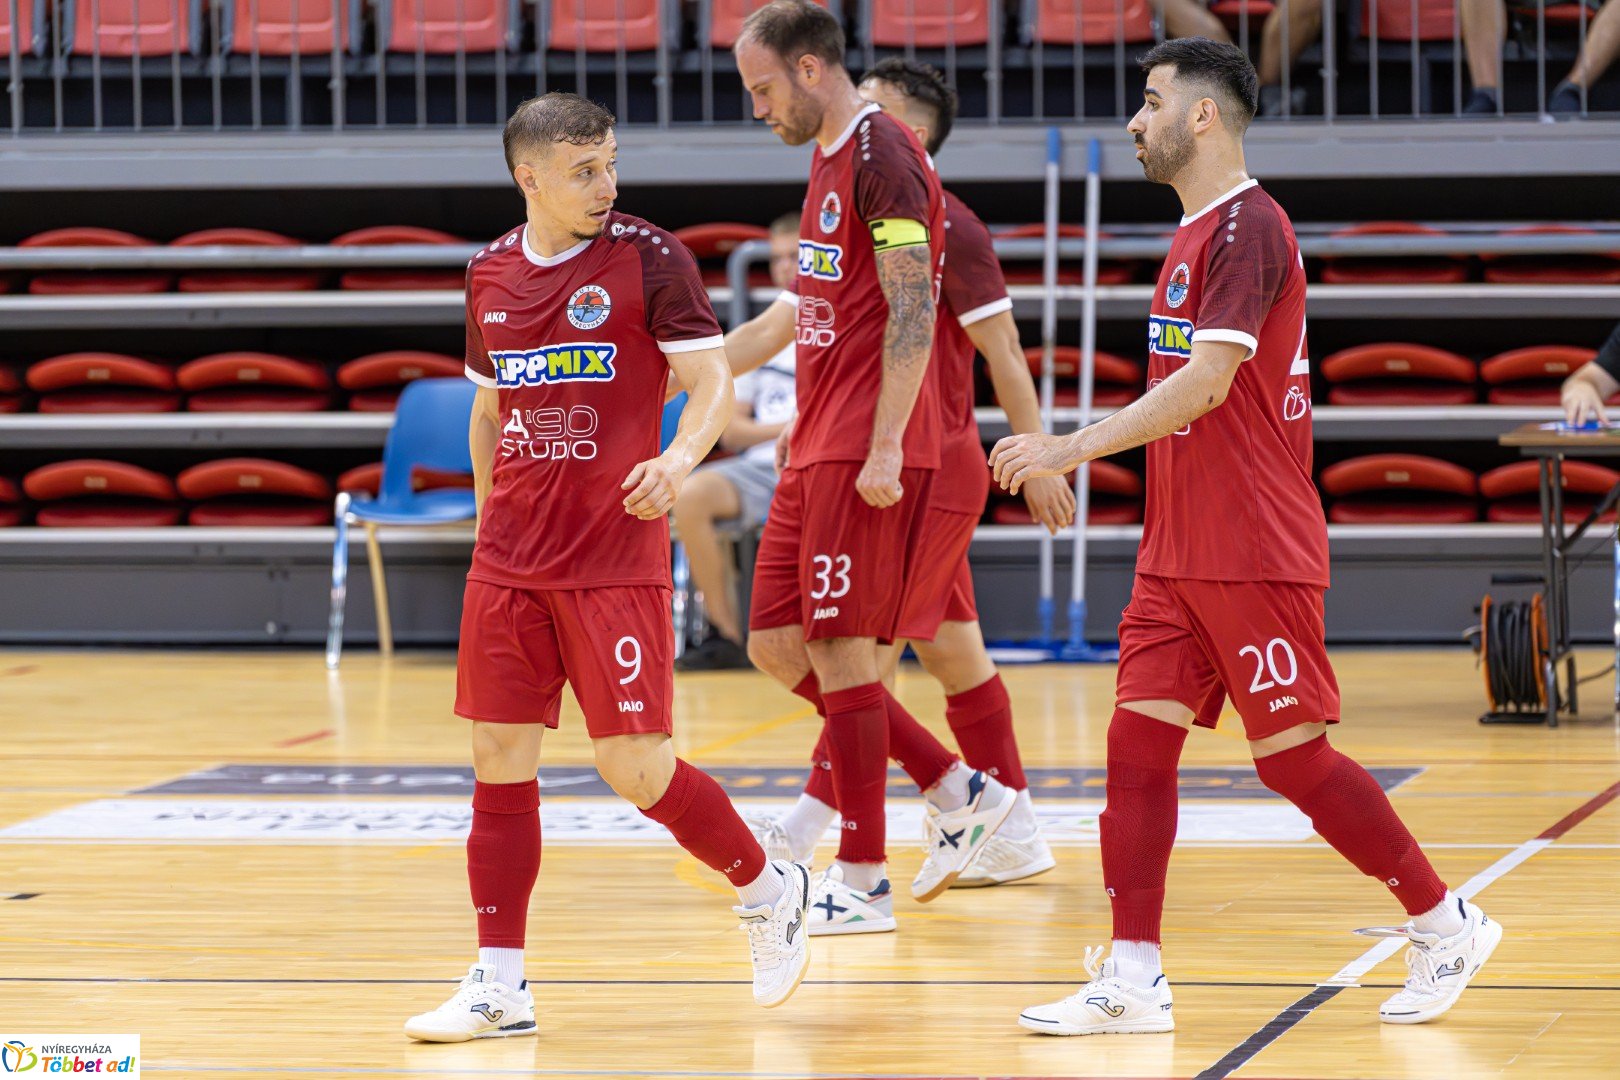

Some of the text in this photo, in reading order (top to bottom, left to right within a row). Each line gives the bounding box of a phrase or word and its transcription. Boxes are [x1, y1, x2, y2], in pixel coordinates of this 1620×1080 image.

[483, 311, 507, 324] JAKO
[501, 438, 597, 460] STUDIO
[810, 554, 852, 600] 33
[615, 635, 642, 685] 9
[1238, 637, 1298, 694] 20
[724, 859, 742, 874] KO
[477, 905, 497, 914] KO
